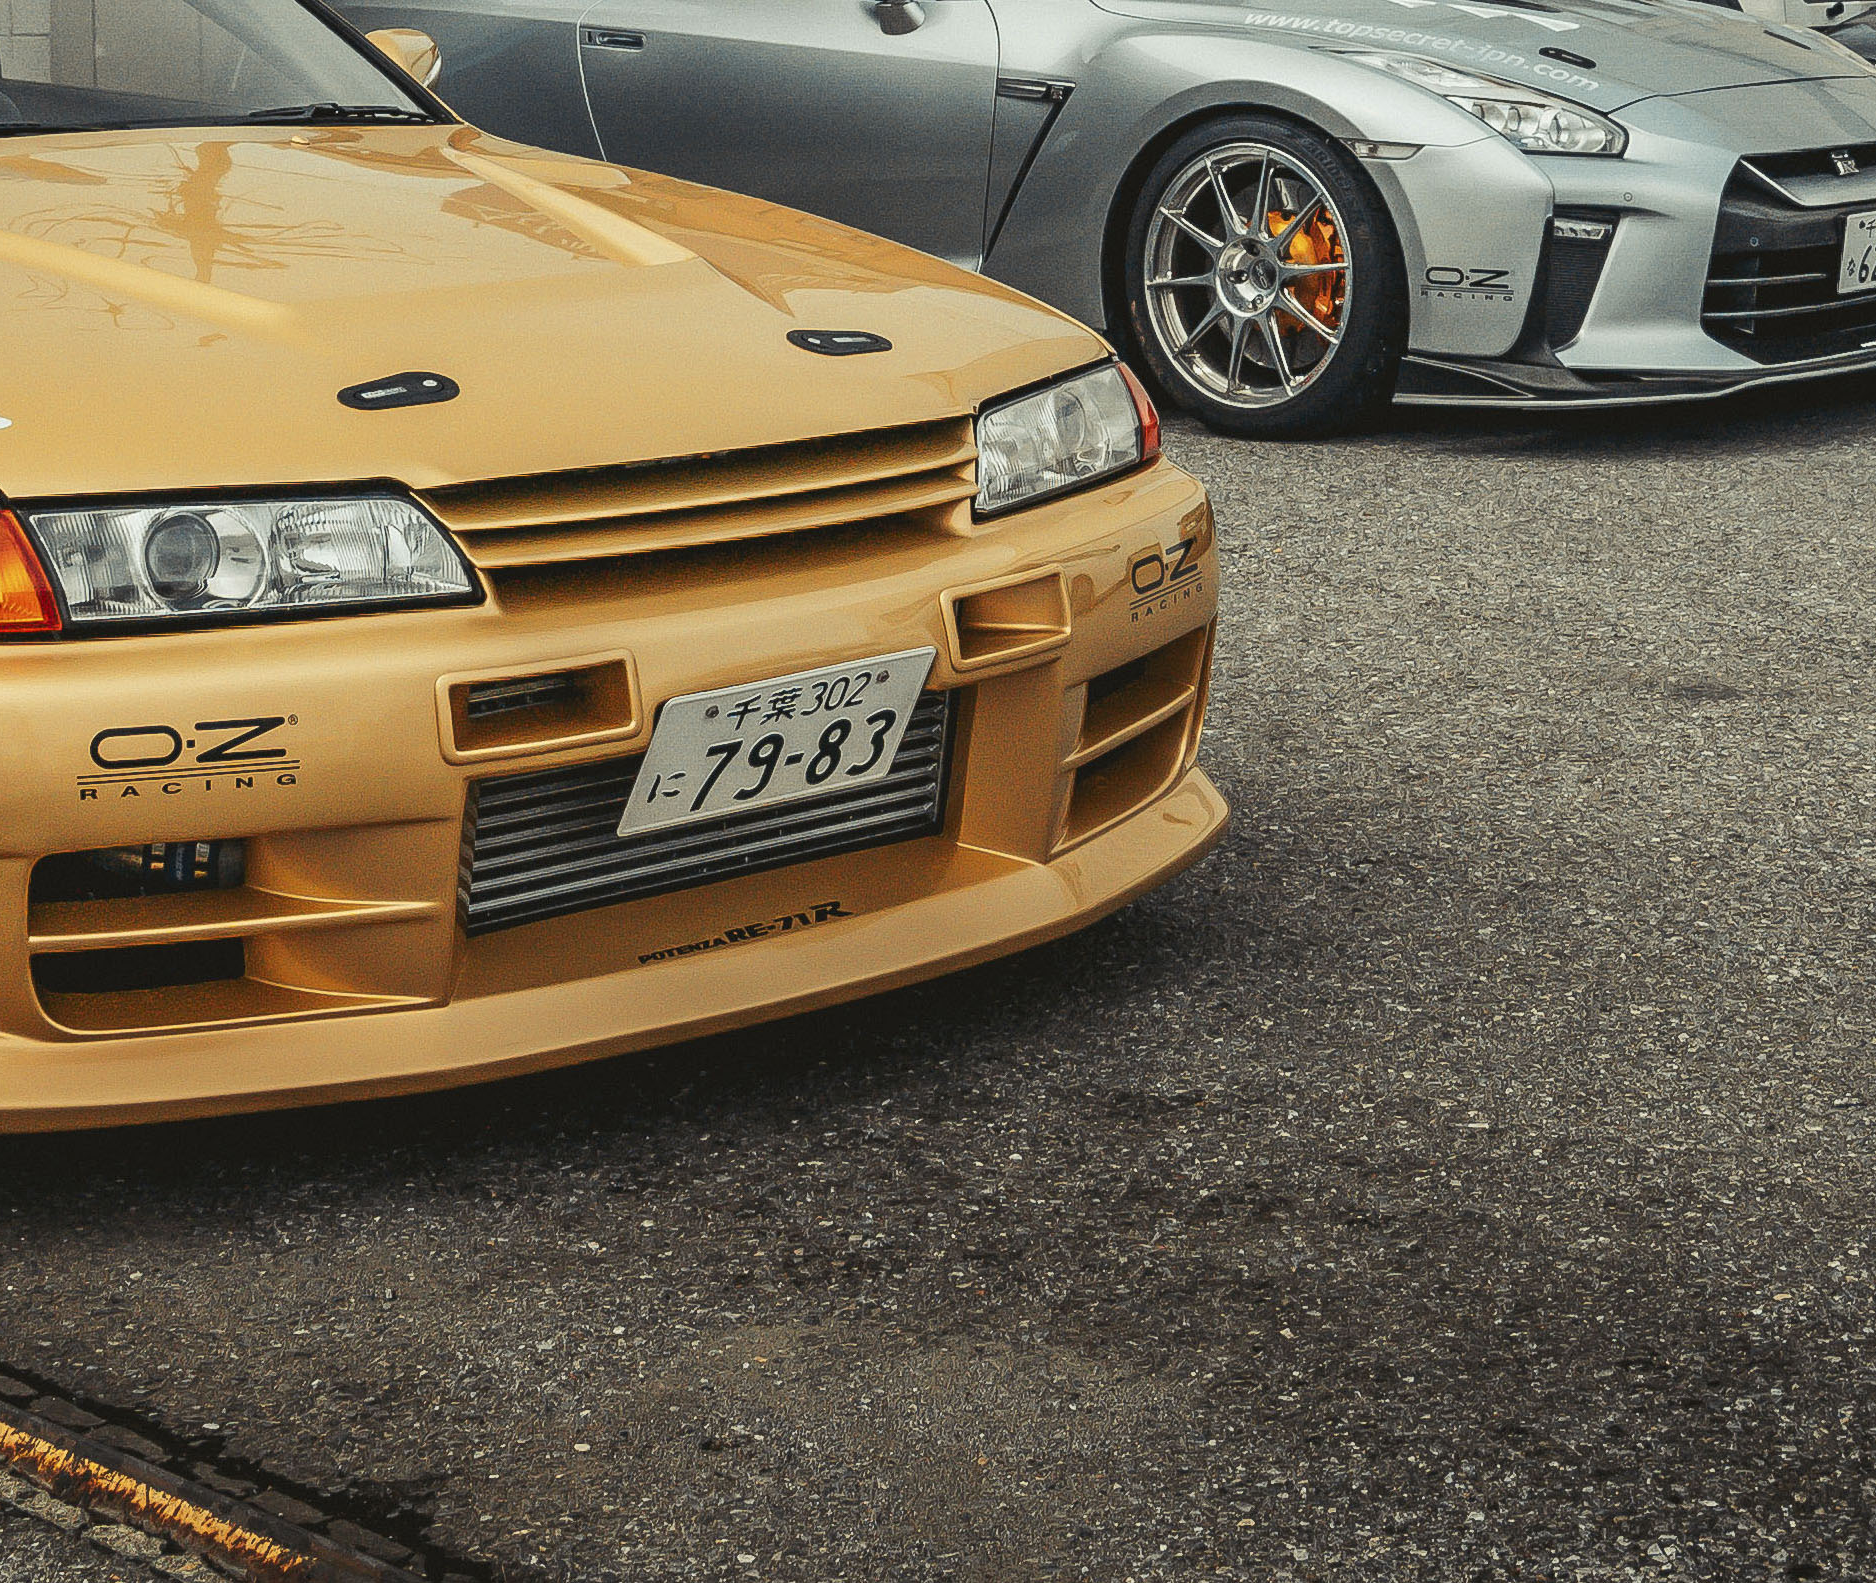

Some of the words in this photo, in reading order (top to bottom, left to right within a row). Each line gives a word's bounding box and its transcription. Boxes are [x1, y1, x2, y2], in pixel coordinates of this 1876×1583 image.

[1420, 290, 1514, 302] RACING
[1130, 582, 1203, 622] RACING
[726, 686, 804, 731] 千葉
[800, 671, 873, 717] 302
[646, 771, 687, 804] に
[690, 708, 898, 813] 79-83
[79, 773, 298, 801] RACING
[637, 937, 726, 965] POTENZA
[724, 901, 853, 943] RE-71R
